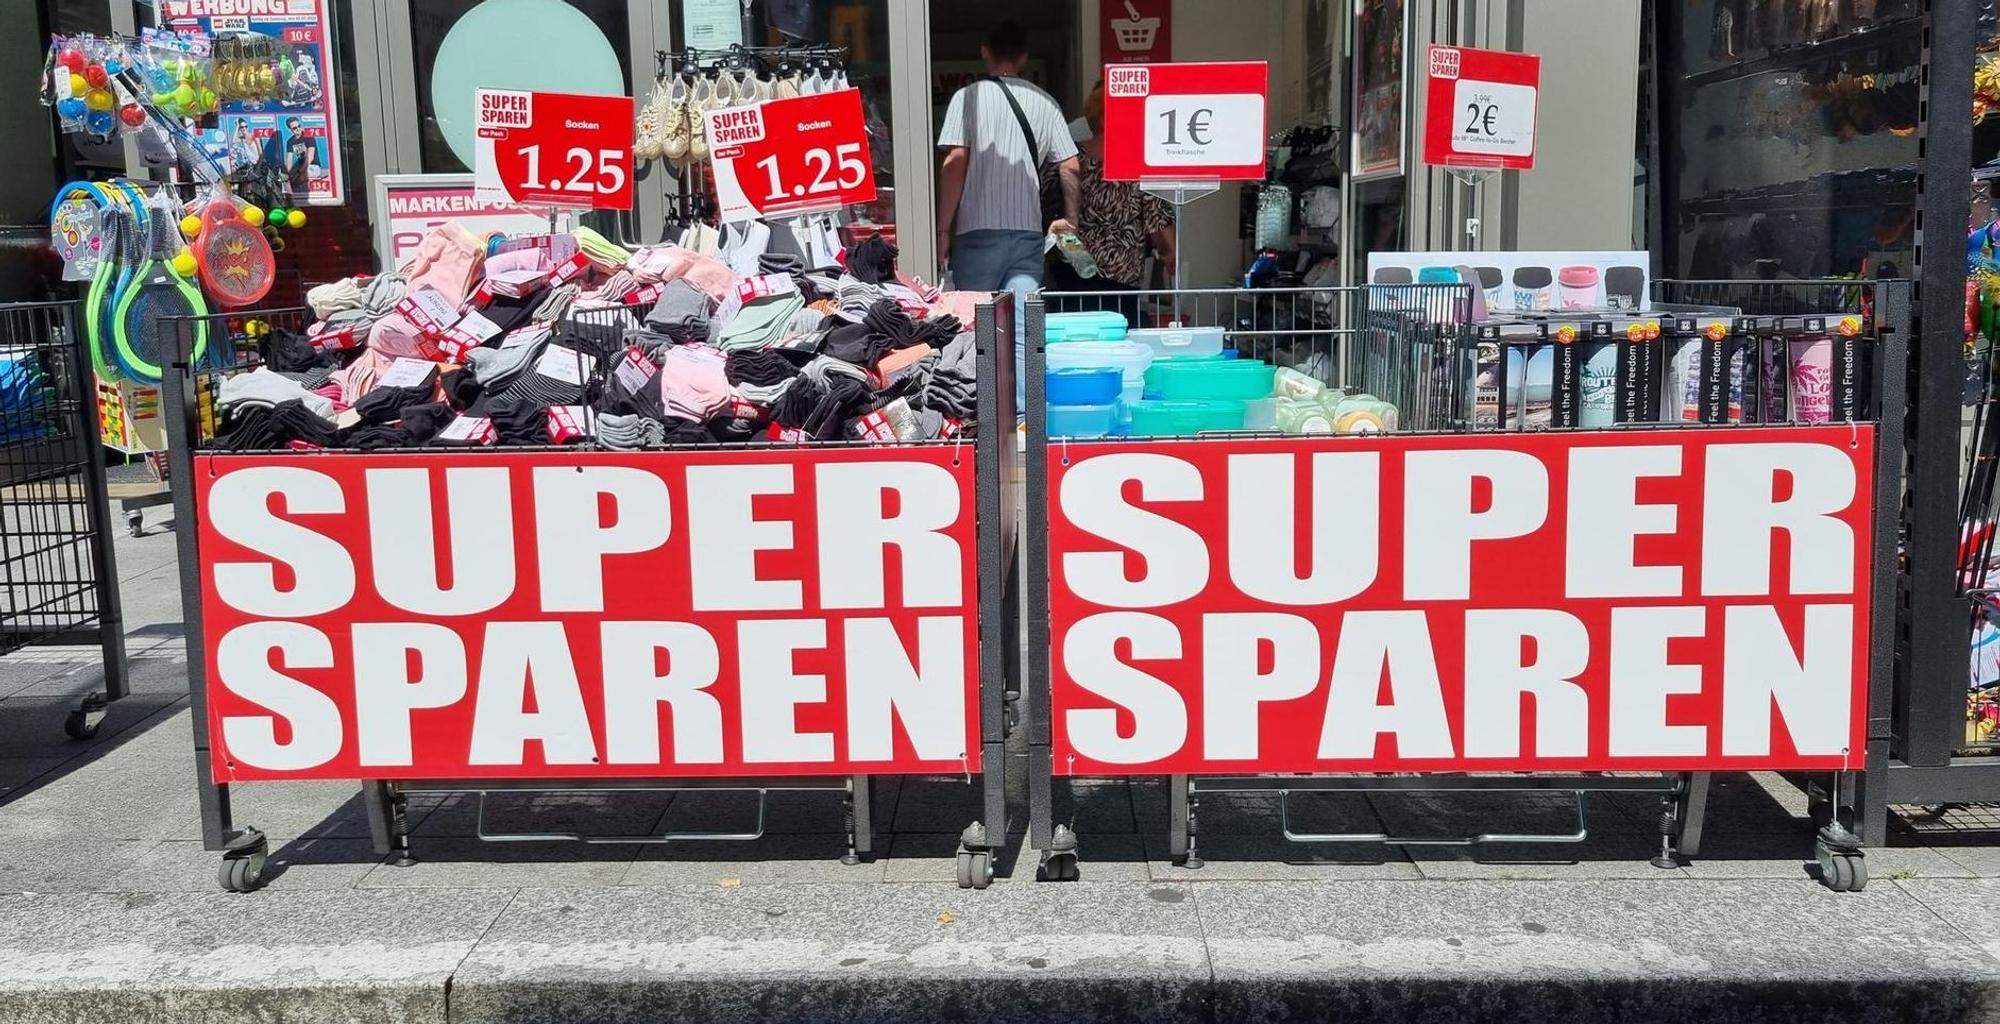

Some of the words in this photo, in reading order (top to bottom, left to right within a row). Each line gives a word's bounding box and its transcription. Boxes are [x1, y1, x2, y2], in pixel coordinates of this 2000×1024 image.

[168, 0, 285, 15] WERBUNG
[290, 31, 303, 41] 10
[1432, 50, 1459, 65] SUPER
[1111, 71, 1147, 83] SUPER
[1431, 64, 1458, 76] SPAREN
[1111, 82, 1147, 94] SPAREN
[482, 94, 527, 111] SUPER
[482, 109, 528, 125] SPAREN
[565, 119, 600, 130] Socken
[712, 110, 758, 129] SUPER
[797, 119, 832, 132] Socken
[1465, 103, 1499, 136] 2€
[715, 125, 761, 144] SPAREN
[1159, 108, 1213, 145] 1€
[1166, 148, 1205, 156] Trinkflasche
[517, 145, 626, 194] 1.25
[756, 142, 866, 201] 1.25
[390, 195, 522, 213] MARKENPO
[1561, 346, 1572, 390] Freedom
[1626, 345, 1637, 388] Freedom
[1709, 341, 1721, 383] Freedom
[1843, 340, 1853, 385] Freedom
[1561, 392, 1570, 408] the
[1626, 391, 1636, 407] the
[1709, 384, 1720, 400] the
[1843, 388, 1853, 404] the
[1626, 408, 1635, 423] eel
[1709, 401, 1719, 423] Feel
[1058, 443, 1858, 609] SUPER
[207, 461, 962, 618] SUPER
[216, 615, 966, 772] SPAREN
[1062, 604, 1855, 766] SPAREN
